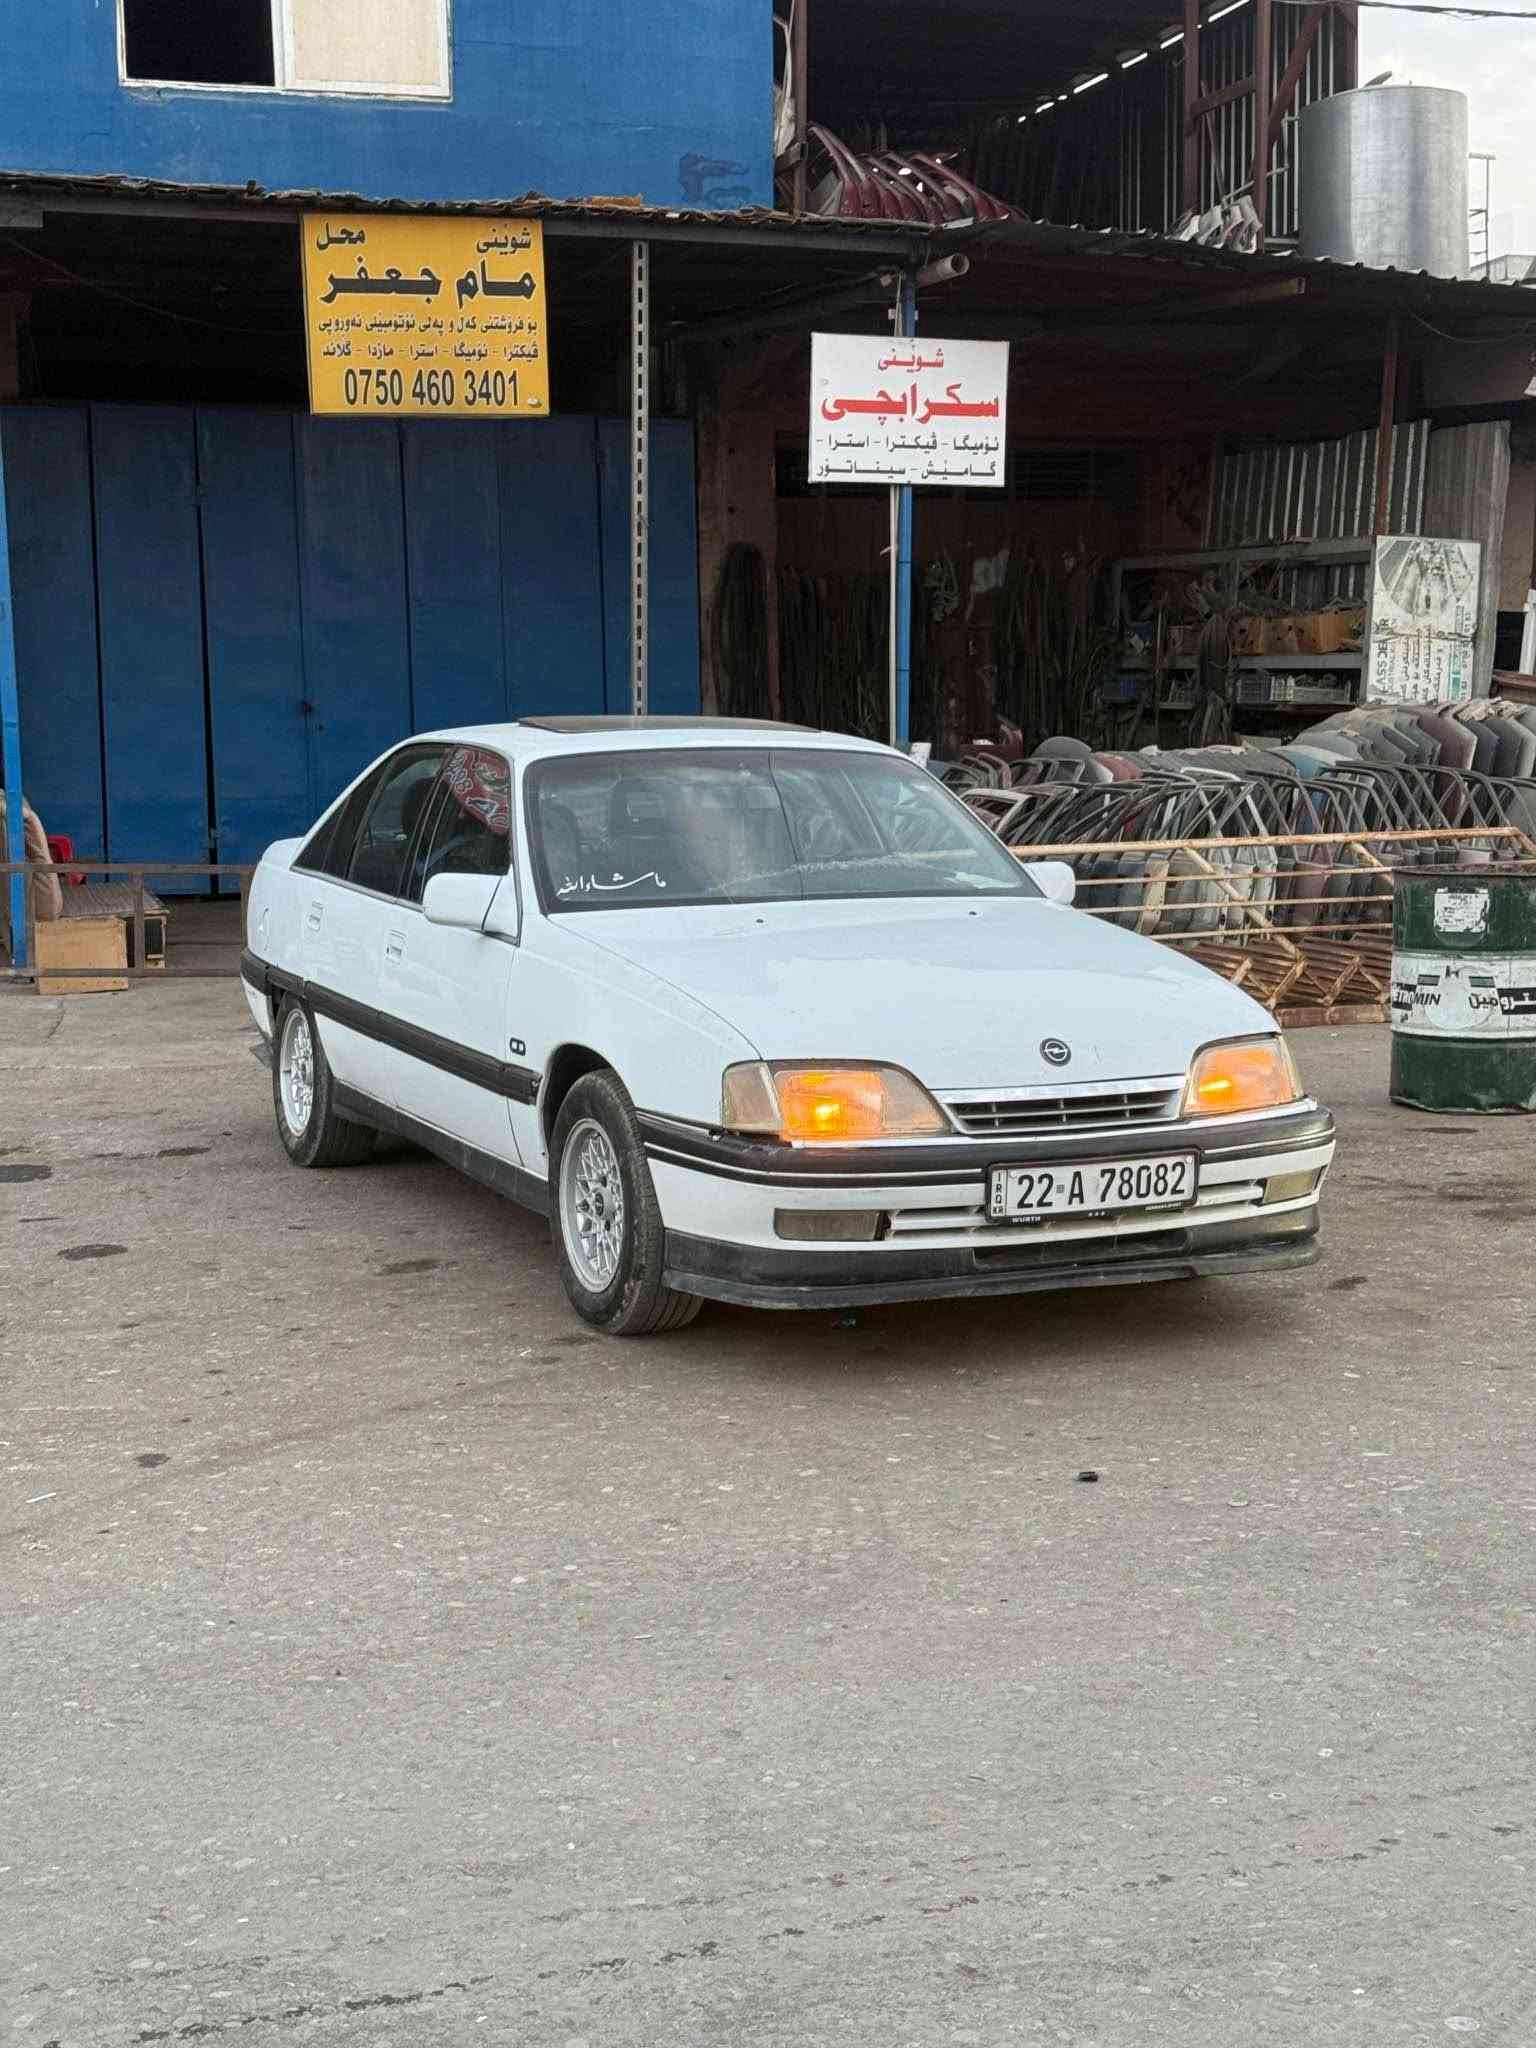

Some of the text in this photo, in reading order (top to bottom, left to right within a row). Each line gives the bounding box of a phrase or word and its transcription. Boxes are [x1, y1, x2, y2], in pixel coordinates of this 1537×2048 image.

[316, 221, 366, 250] محل
[319, 255, 536, 309] مام جعفر
[344, 368, 519, 407] 0750 460 3401
[820, 383, 999, 426] سکرابچی
[828, 433, 870, 451] استرا
[1017, 1161, 1187, 1210] 22 A 78082
